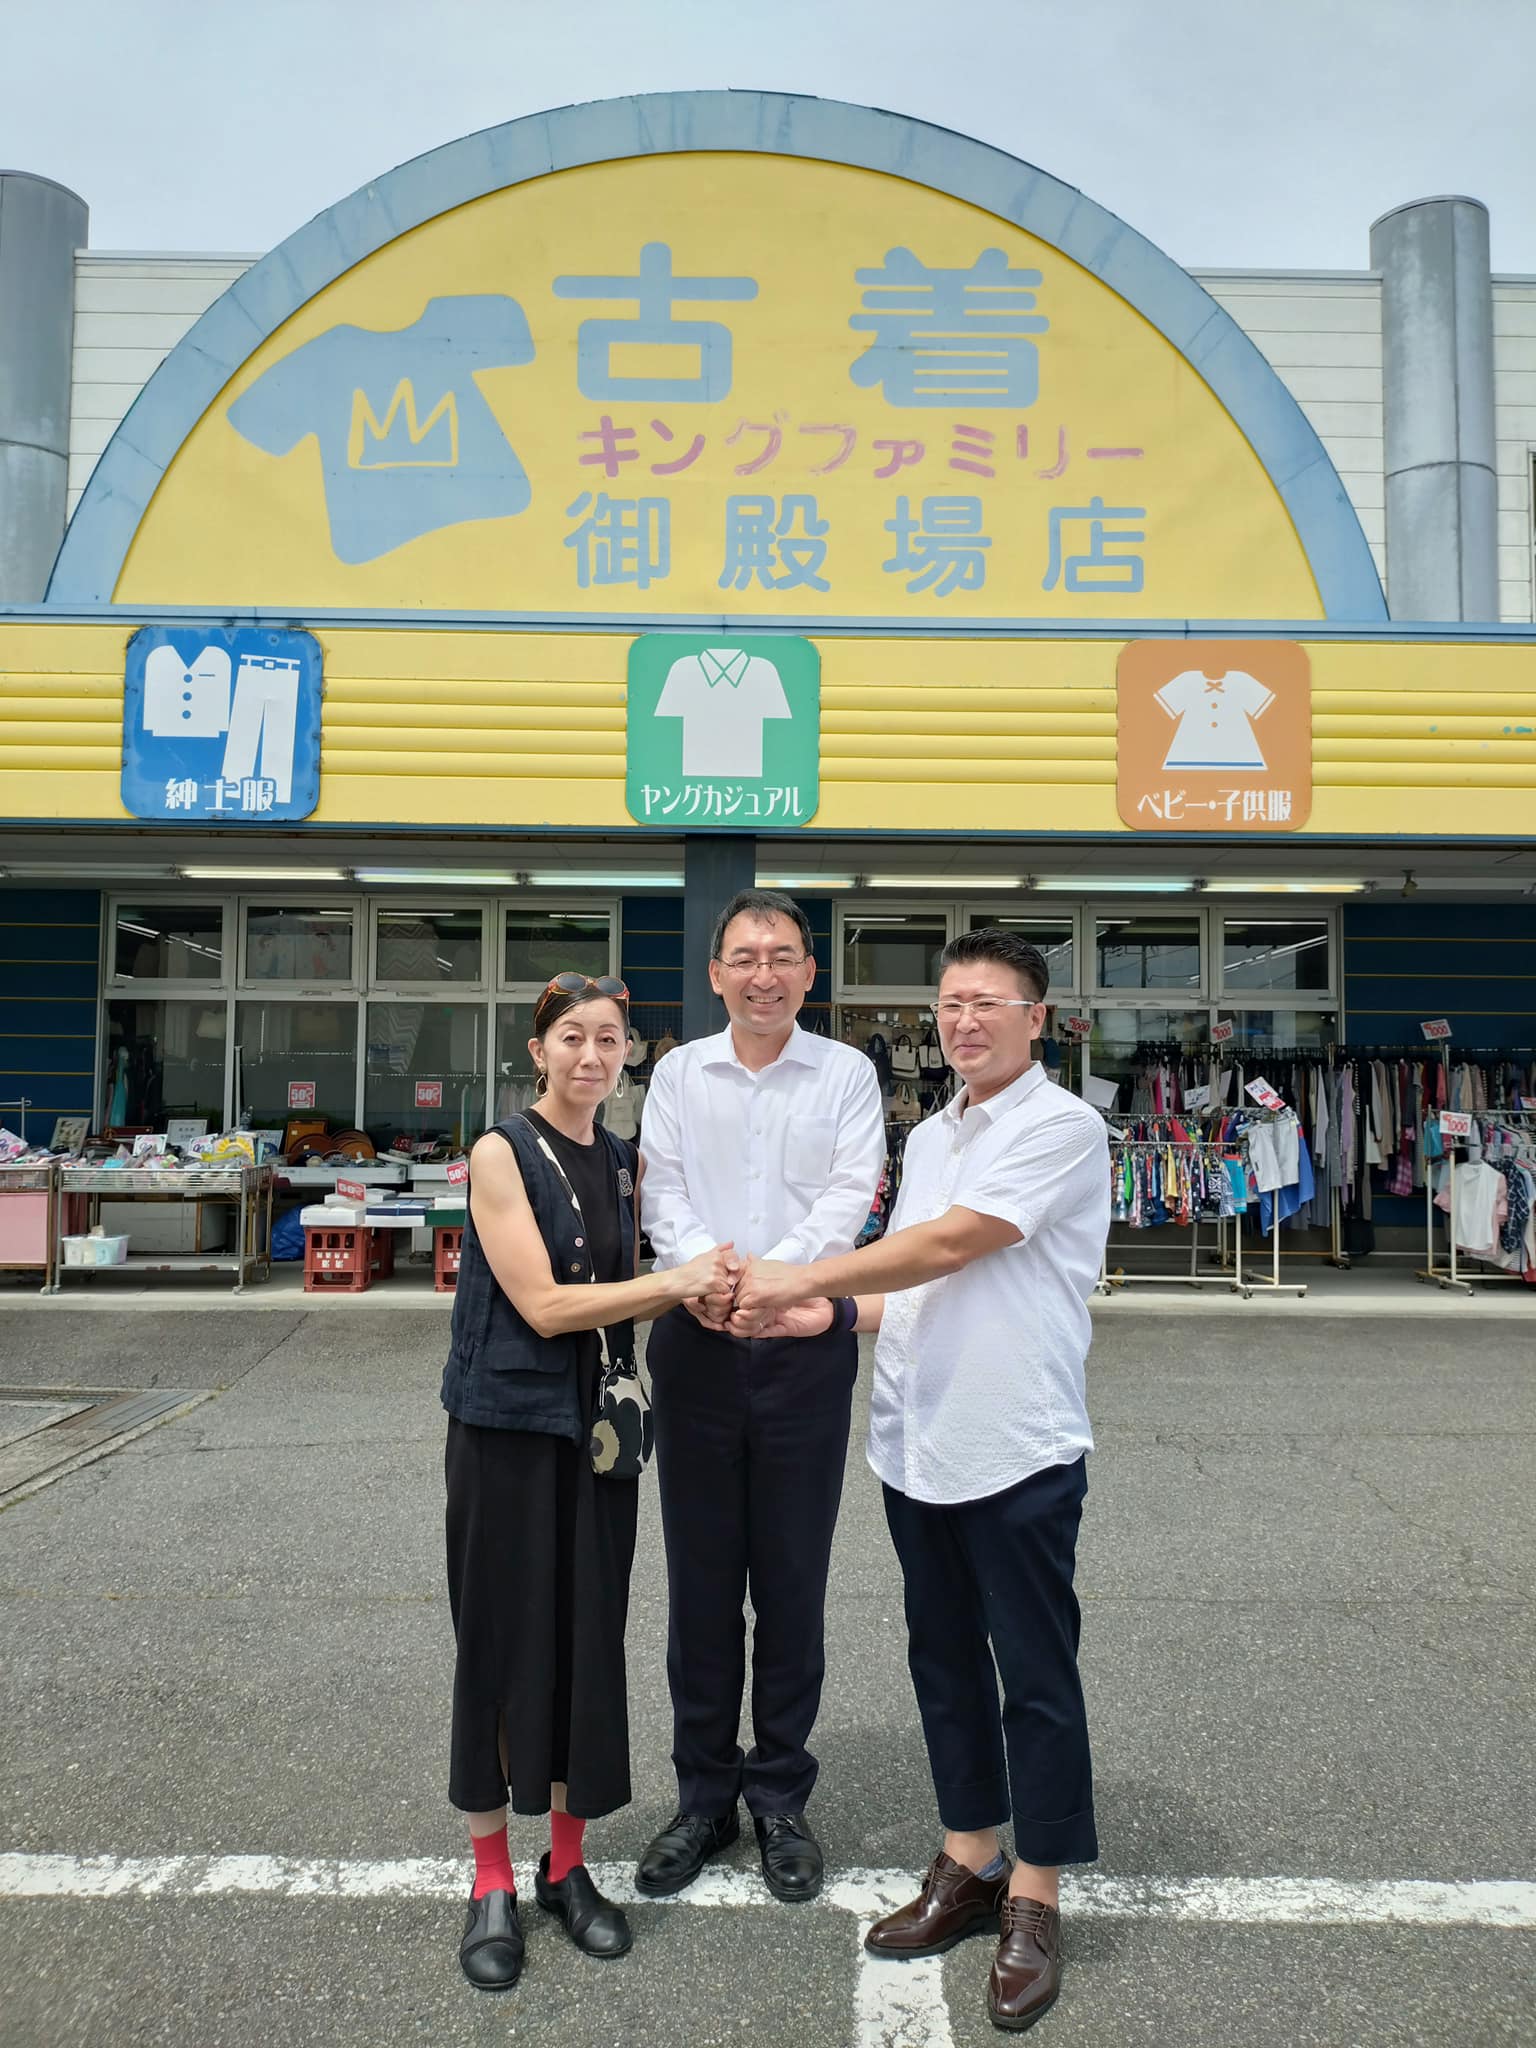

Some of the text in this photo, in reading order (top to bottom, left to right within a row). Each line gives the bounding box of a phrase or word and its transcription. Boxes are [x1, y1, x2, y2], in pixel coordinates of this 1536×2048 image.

[552, 241, 1050, 408] 古着
[578, 411, 1144, 479] キングファミリー
[563, 491, 1146, 597] 御殿場店
[164, 778, 274, 812] 紳士服
[640, 784, 804, 817] ヤングカジュアル
